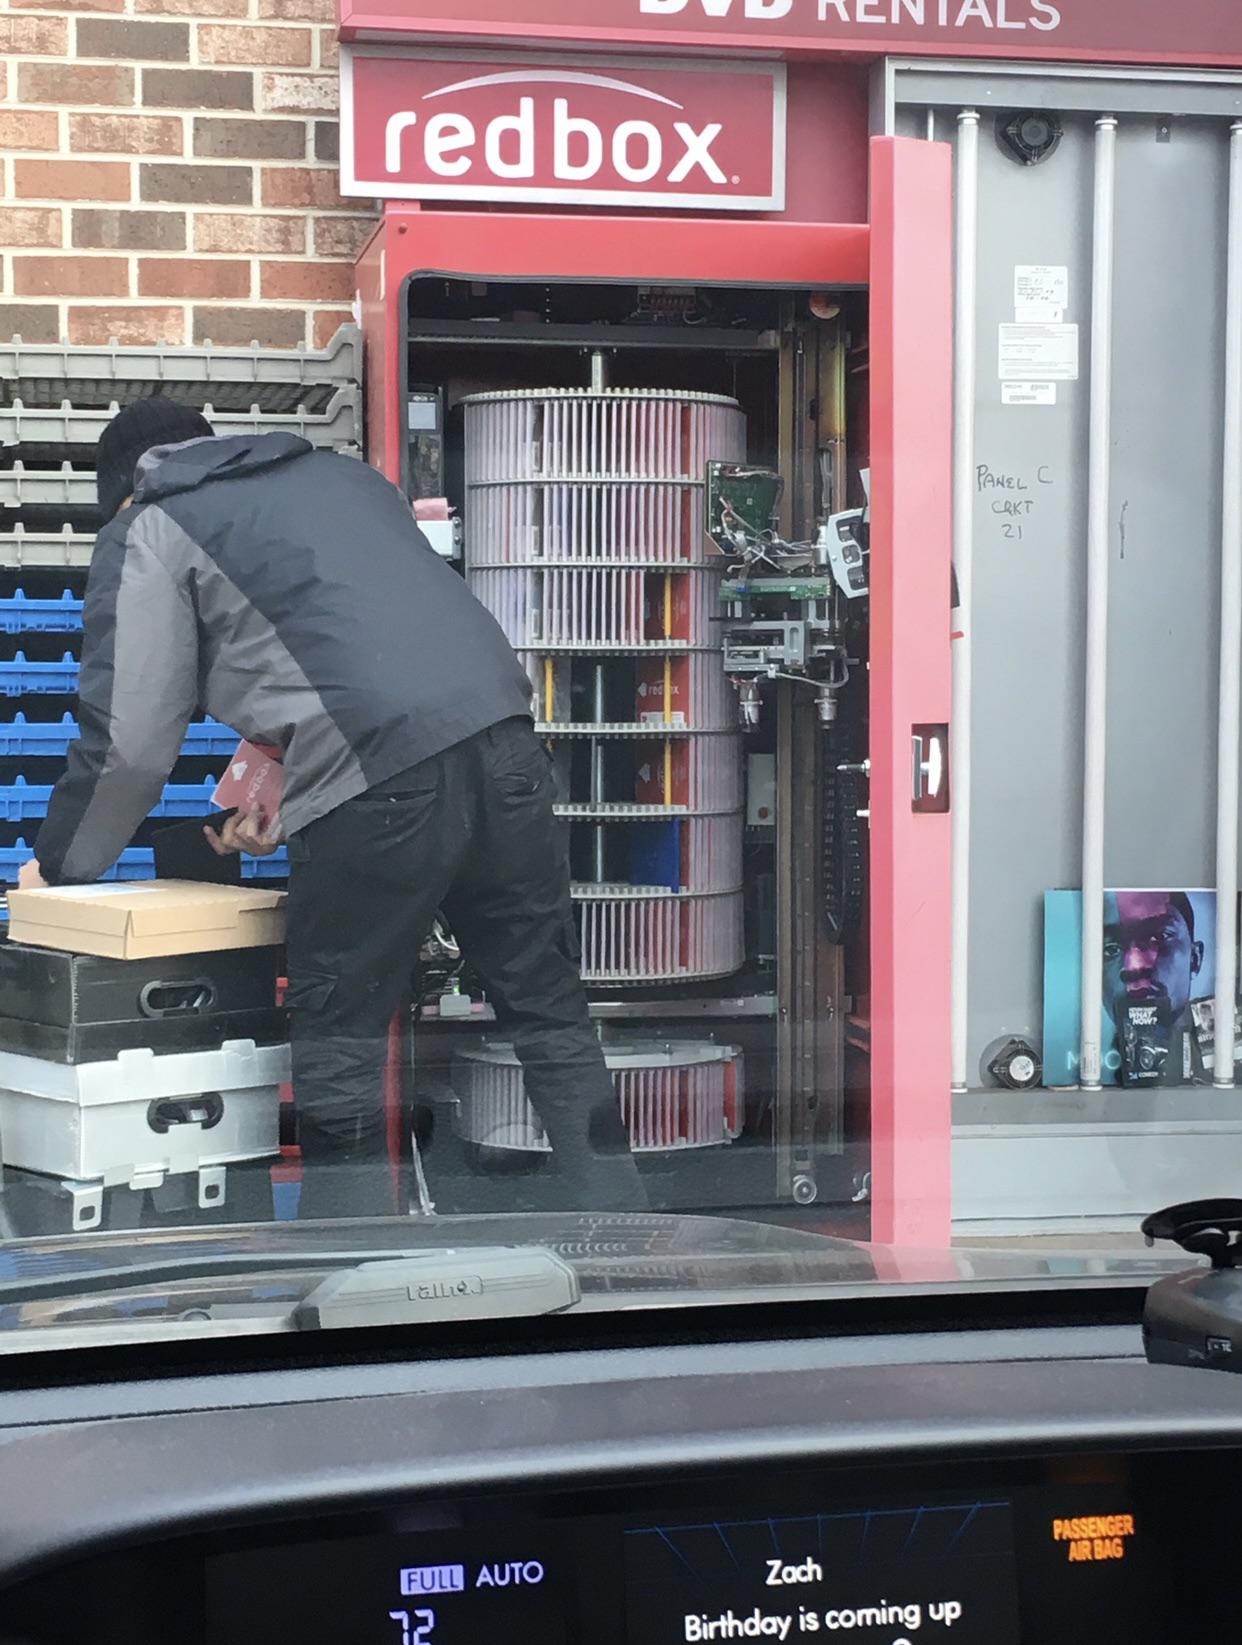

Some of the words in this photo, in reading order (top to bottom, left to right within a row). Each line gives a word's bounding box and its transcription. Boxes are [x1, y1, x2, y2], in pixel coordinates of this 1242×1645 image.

[817, 0, 1061, 30] RENTALS
[385, 96, 728, 184] redbox
[976, 464, 1028, 491] PANEL
[1037, 466, 1053, 484] C
[991, 500, 1034, 516] CRKT
[1001, 523, 1022, 539] 21
[648, 684, 680, 696] redx
[1053, 1514, 1134, 1540] PASSENGER
[1069, 1540, 1092, 1562] AIR
[1093, 1538, 1124, 1560] BAG
[406, 1567, 460, 1592] FULL
[475, 1560, 544, 1588] AUTO
[765, 1556, 823, 1585] Zach
[388, 1609, 435, 1645] 72
[684, 1607, 792, 1641] Birthday
[799, 1606, 820, 1631] is
[825, 1599, 921, 1630] coming
[929, 1600, 962, 1627] up
